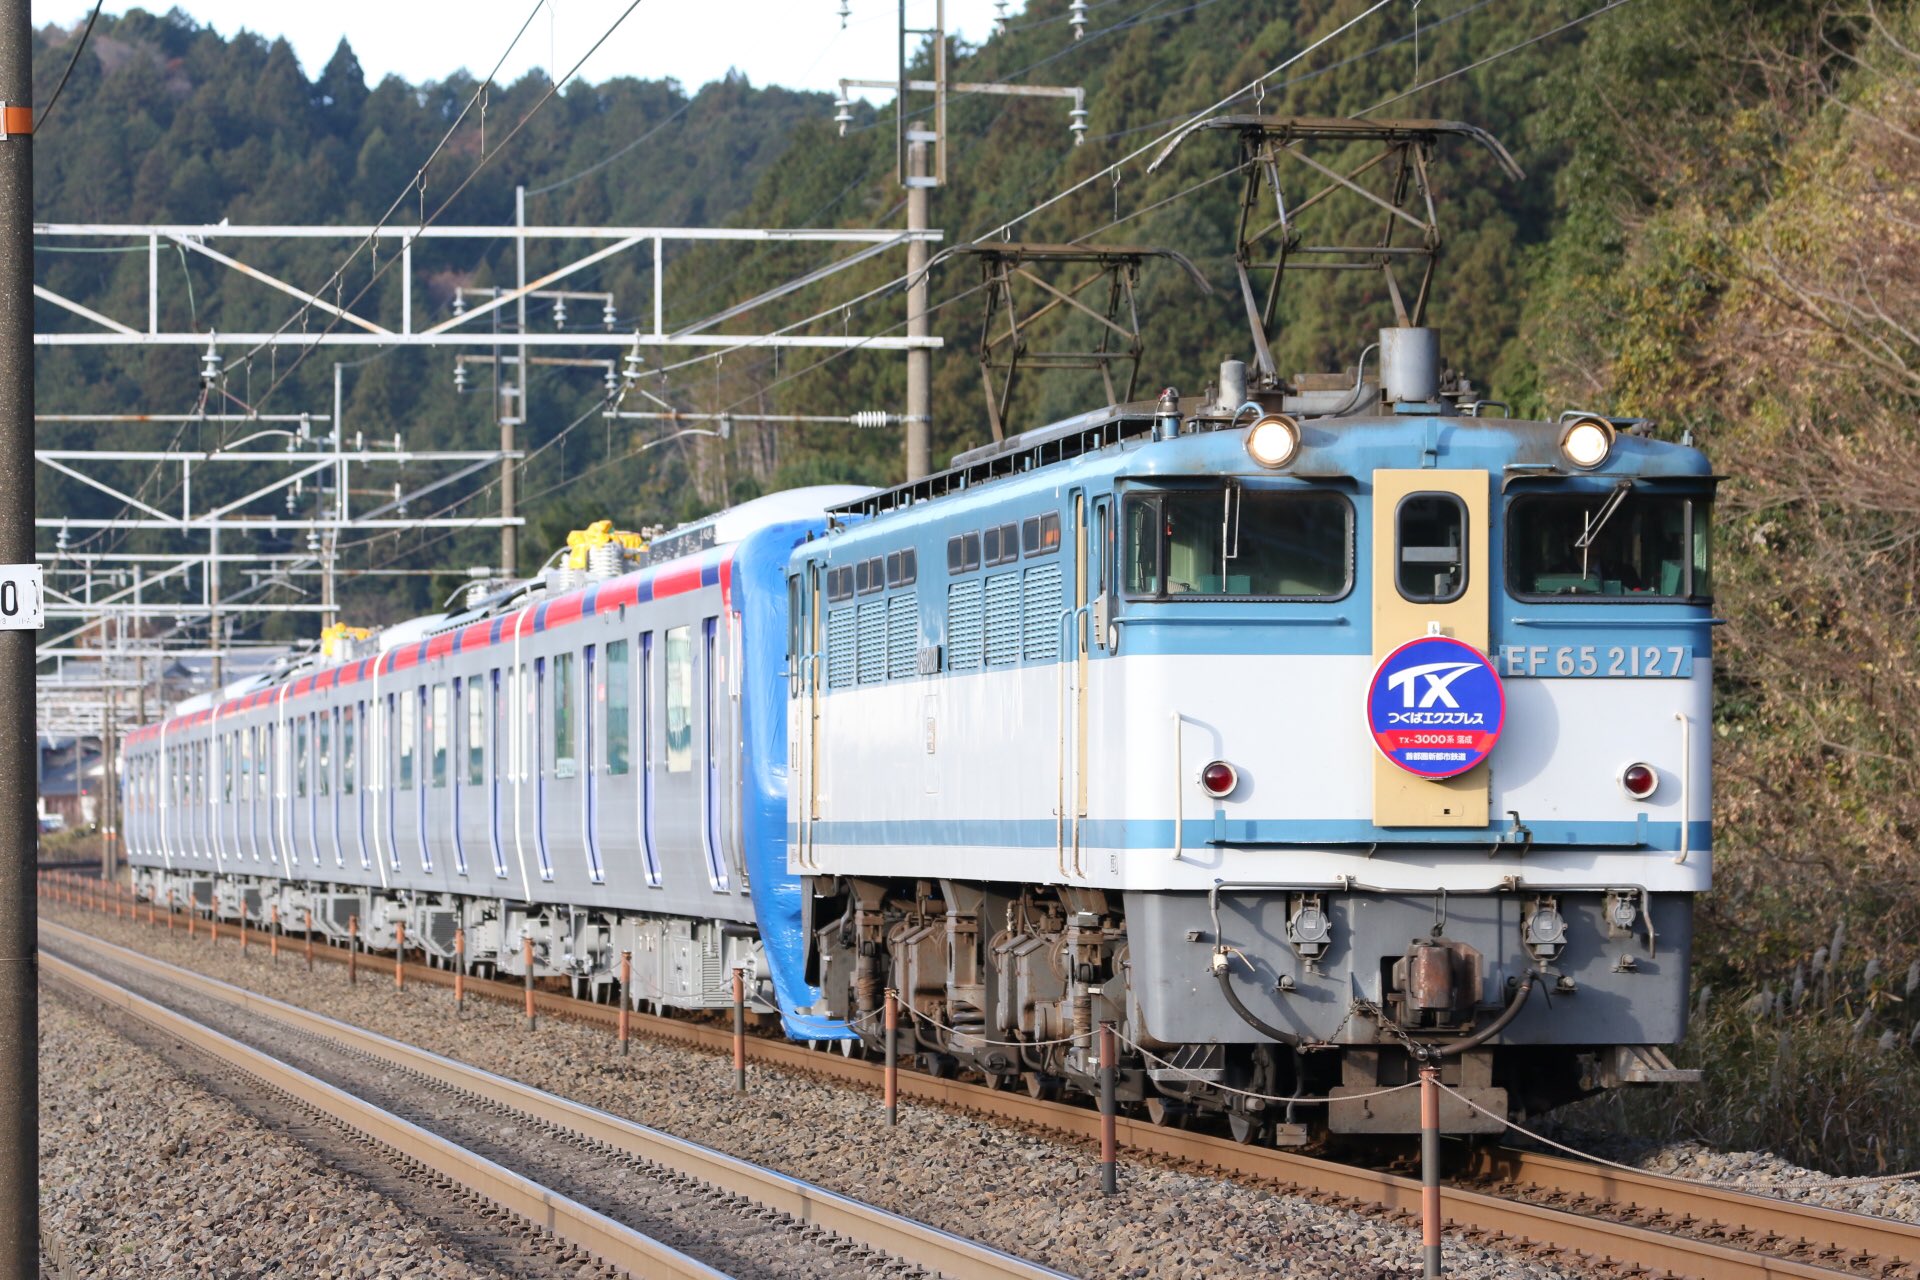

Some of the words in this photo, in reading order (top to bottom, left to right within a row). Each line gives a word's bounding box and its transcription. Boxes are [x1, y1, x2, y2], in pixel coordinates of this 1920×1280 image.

[1507, 646, 1549, 676] EF
[1556, 646, 1599, 676] 65
[1608, 646, 1685, 676] 2127
[1388, 662, 1484, 708] TX
[1388, 712, 1484, 725] つくばエクスプレス
